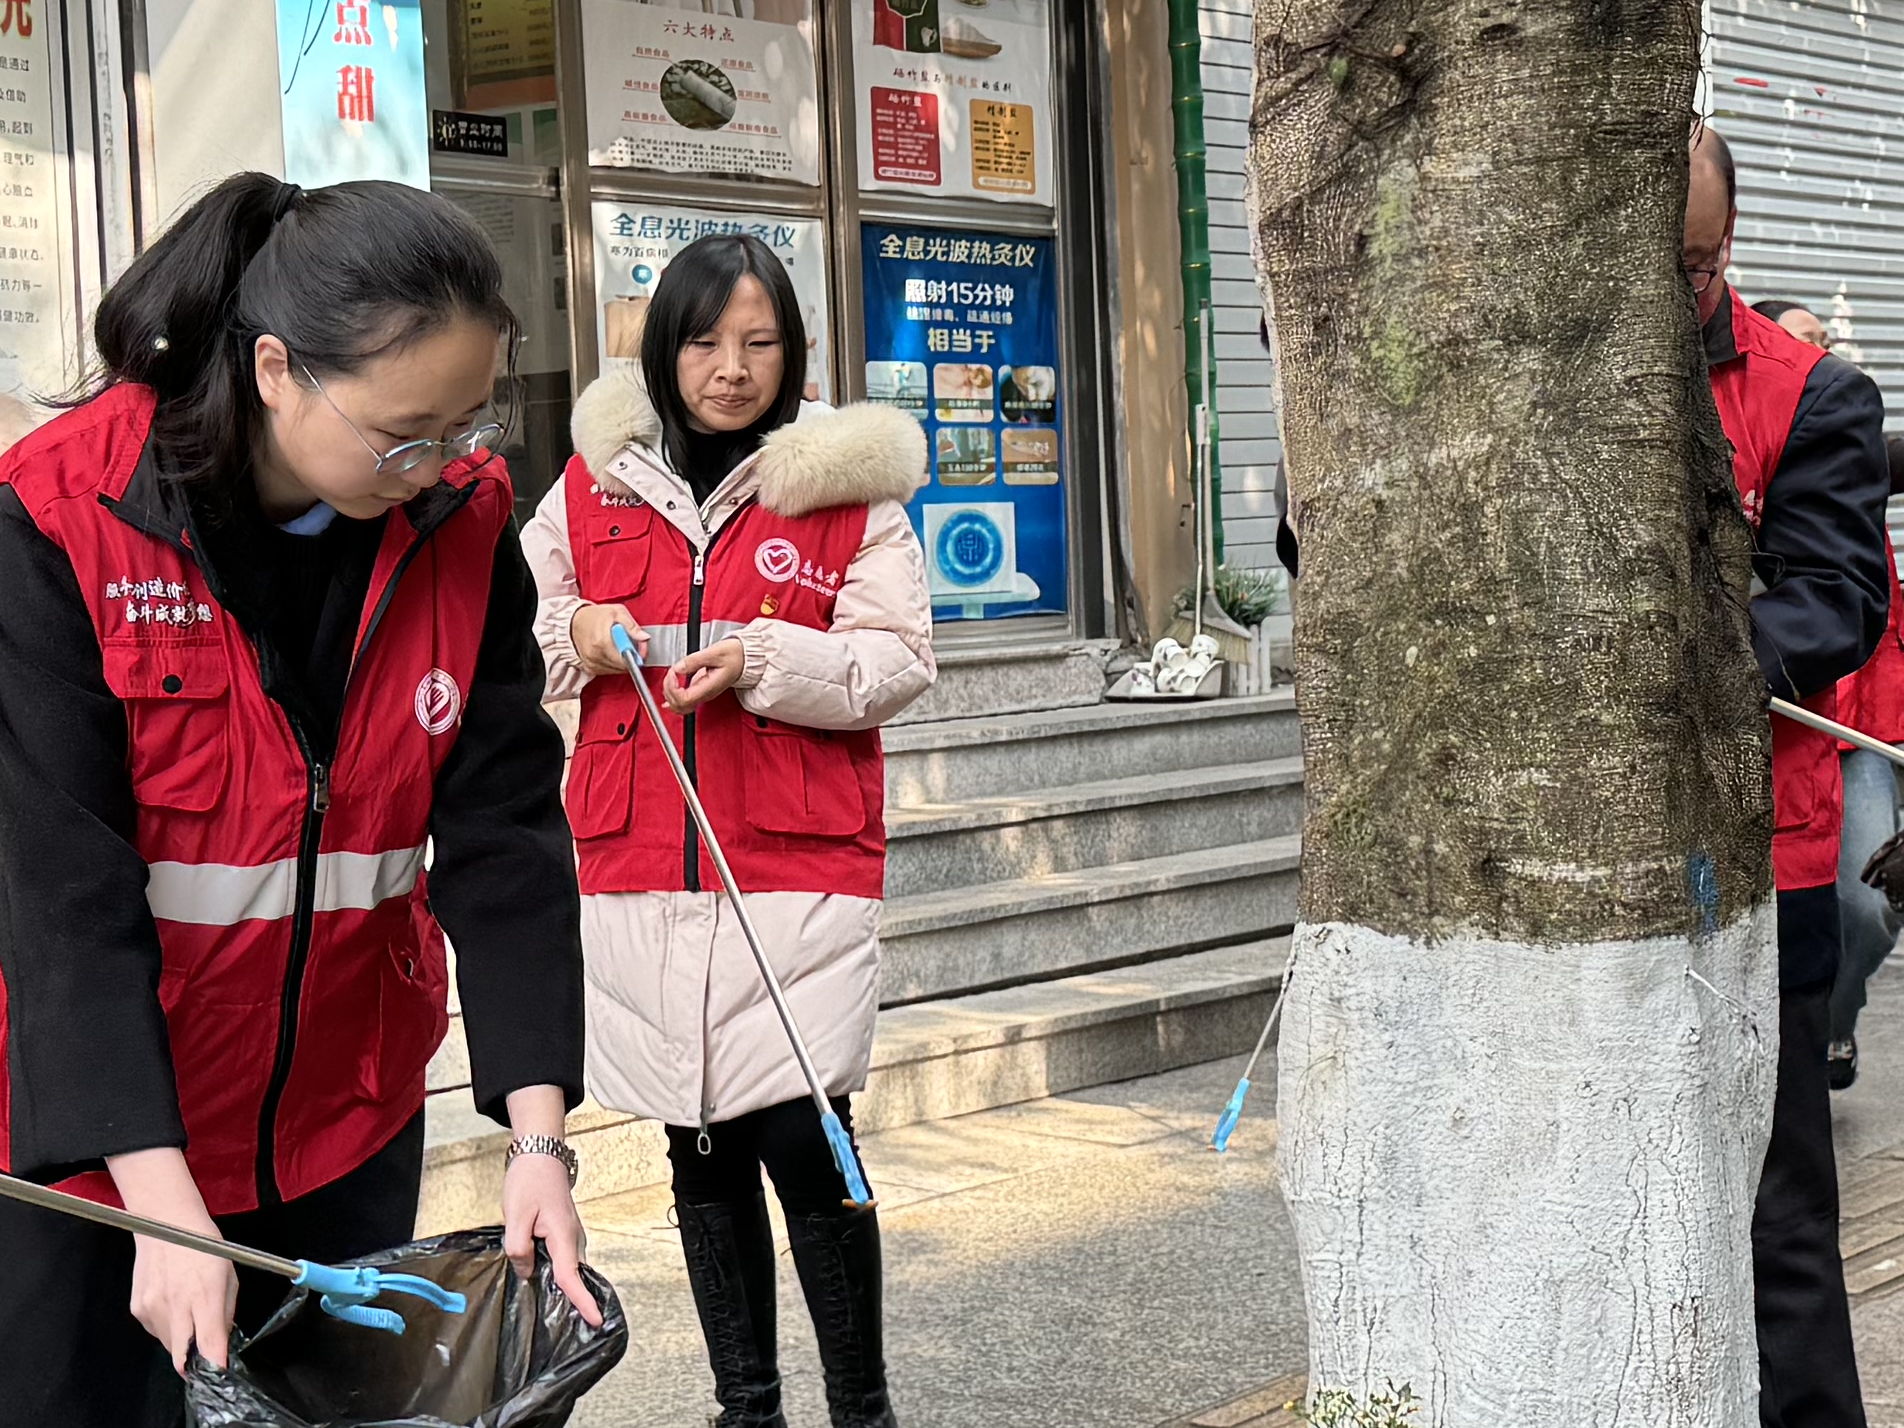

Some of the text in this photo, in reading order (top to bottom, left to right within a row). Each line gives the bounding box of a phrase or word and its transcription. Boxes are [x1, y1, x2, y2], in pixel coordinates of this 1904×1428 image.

[663, 19, 735, 43] 六大特点
[878, 232, 1037, 269] 全息光波热灸仪
[904, 278, 1015, 308] 照射15分钟
[926, 326, 996, 354] 相当于
